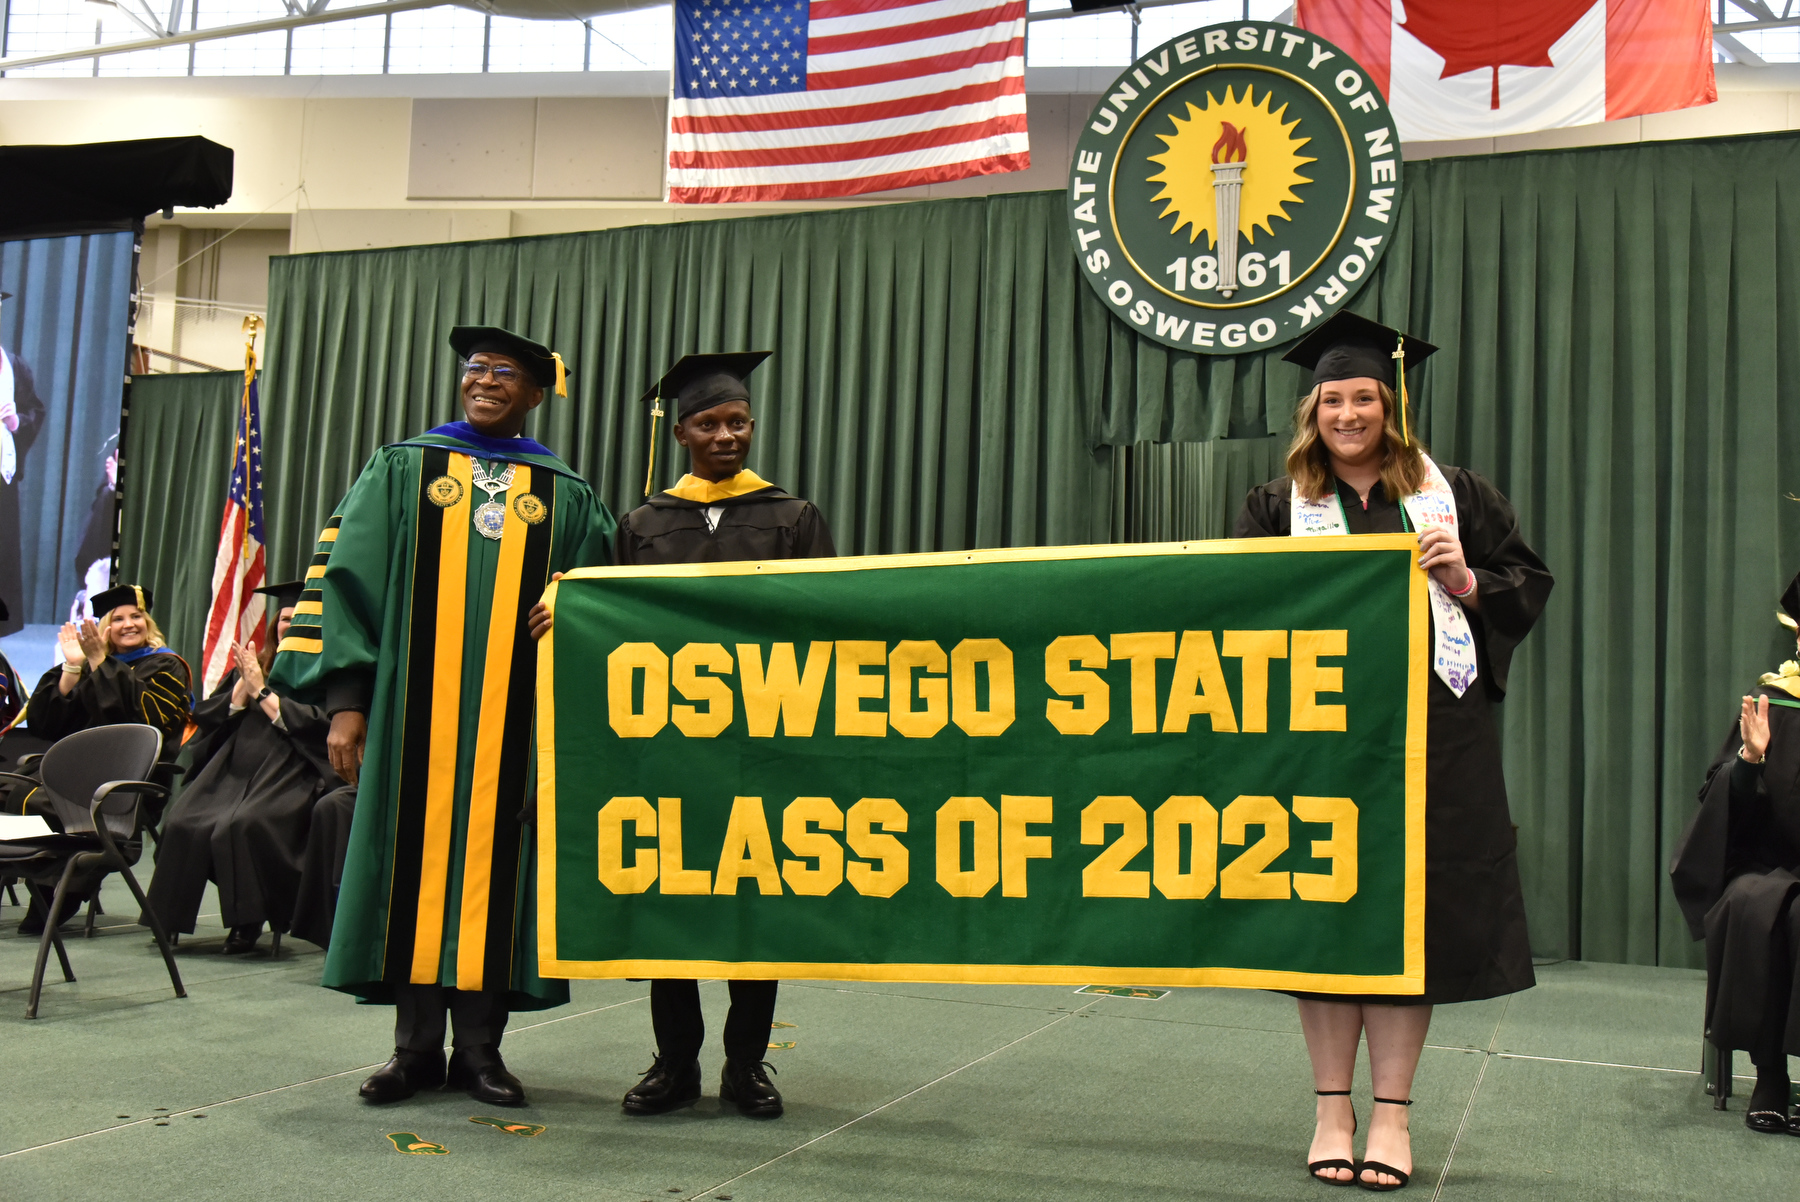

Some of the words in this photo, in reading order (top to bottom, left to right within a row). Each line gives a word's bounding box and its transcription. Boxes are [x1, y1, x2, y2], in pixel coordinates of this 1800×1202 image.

[1090, 26, 1336, 135] UNIVERSITY
[1335, 69, 1379, 114] OF
[1073, 150, 1111, 274] STATE
[1364, 127, 1396, 224] NEW
[1108, 279, 1278, 348] OSWEGO
[1288, 234, 1383, 329] YORK
[608, 638, 1015, 739] OSWEGO
[1045, 629, 1348, 735] STATE
[598, 795, 909, 898] CLASS
[936, 795, 1053, 898] OF
[1081, 795, 1359, 903] 2023
